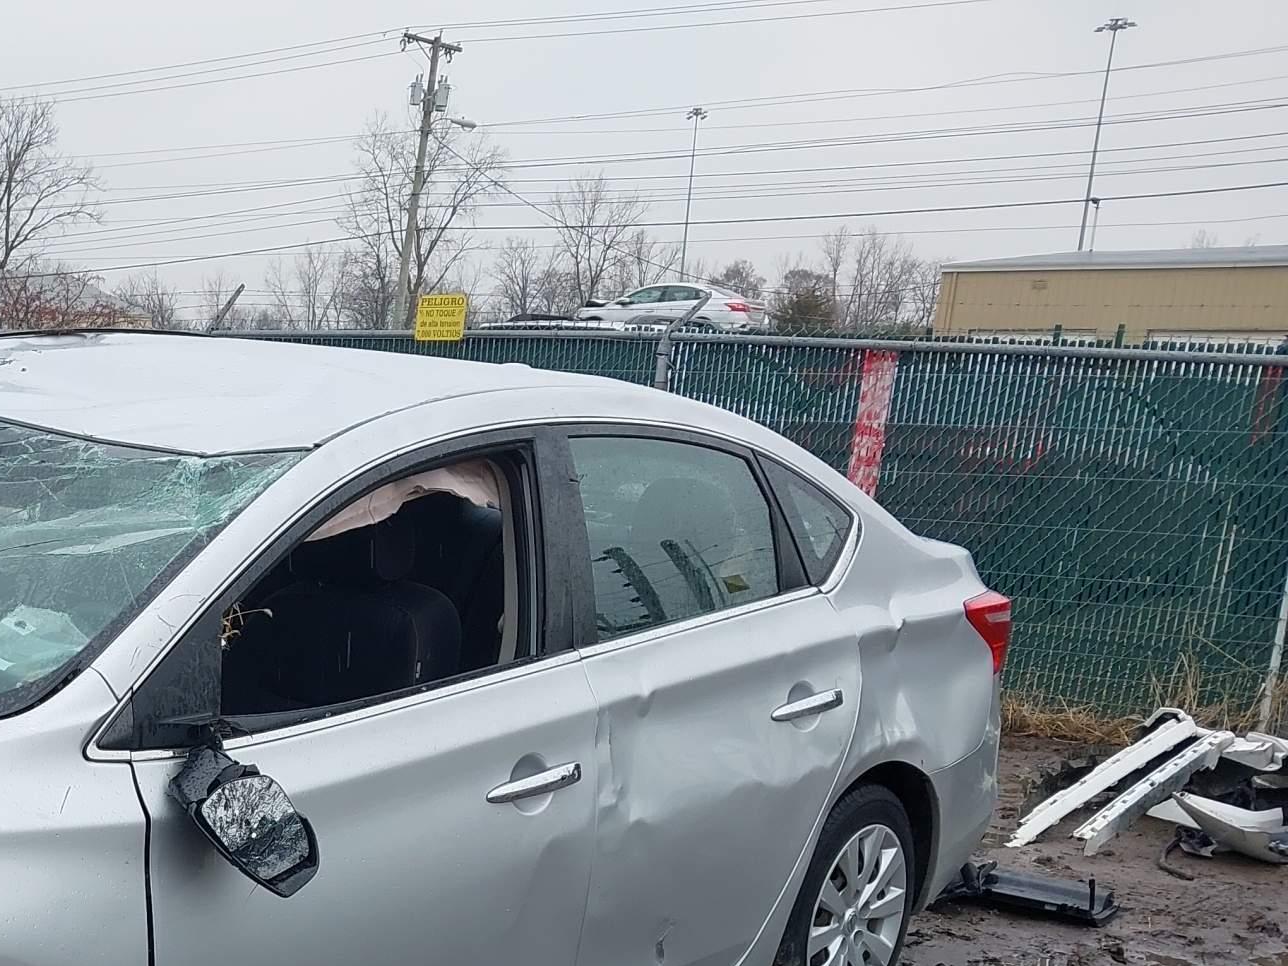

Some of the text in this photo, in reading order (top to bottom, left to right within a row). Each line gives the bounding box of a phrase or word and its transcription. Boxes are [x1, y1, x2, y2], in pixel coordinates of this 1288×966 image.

[421, 297, 464, 306] PELIGRO
[425, 309, 456, 317] NO TOQUE
